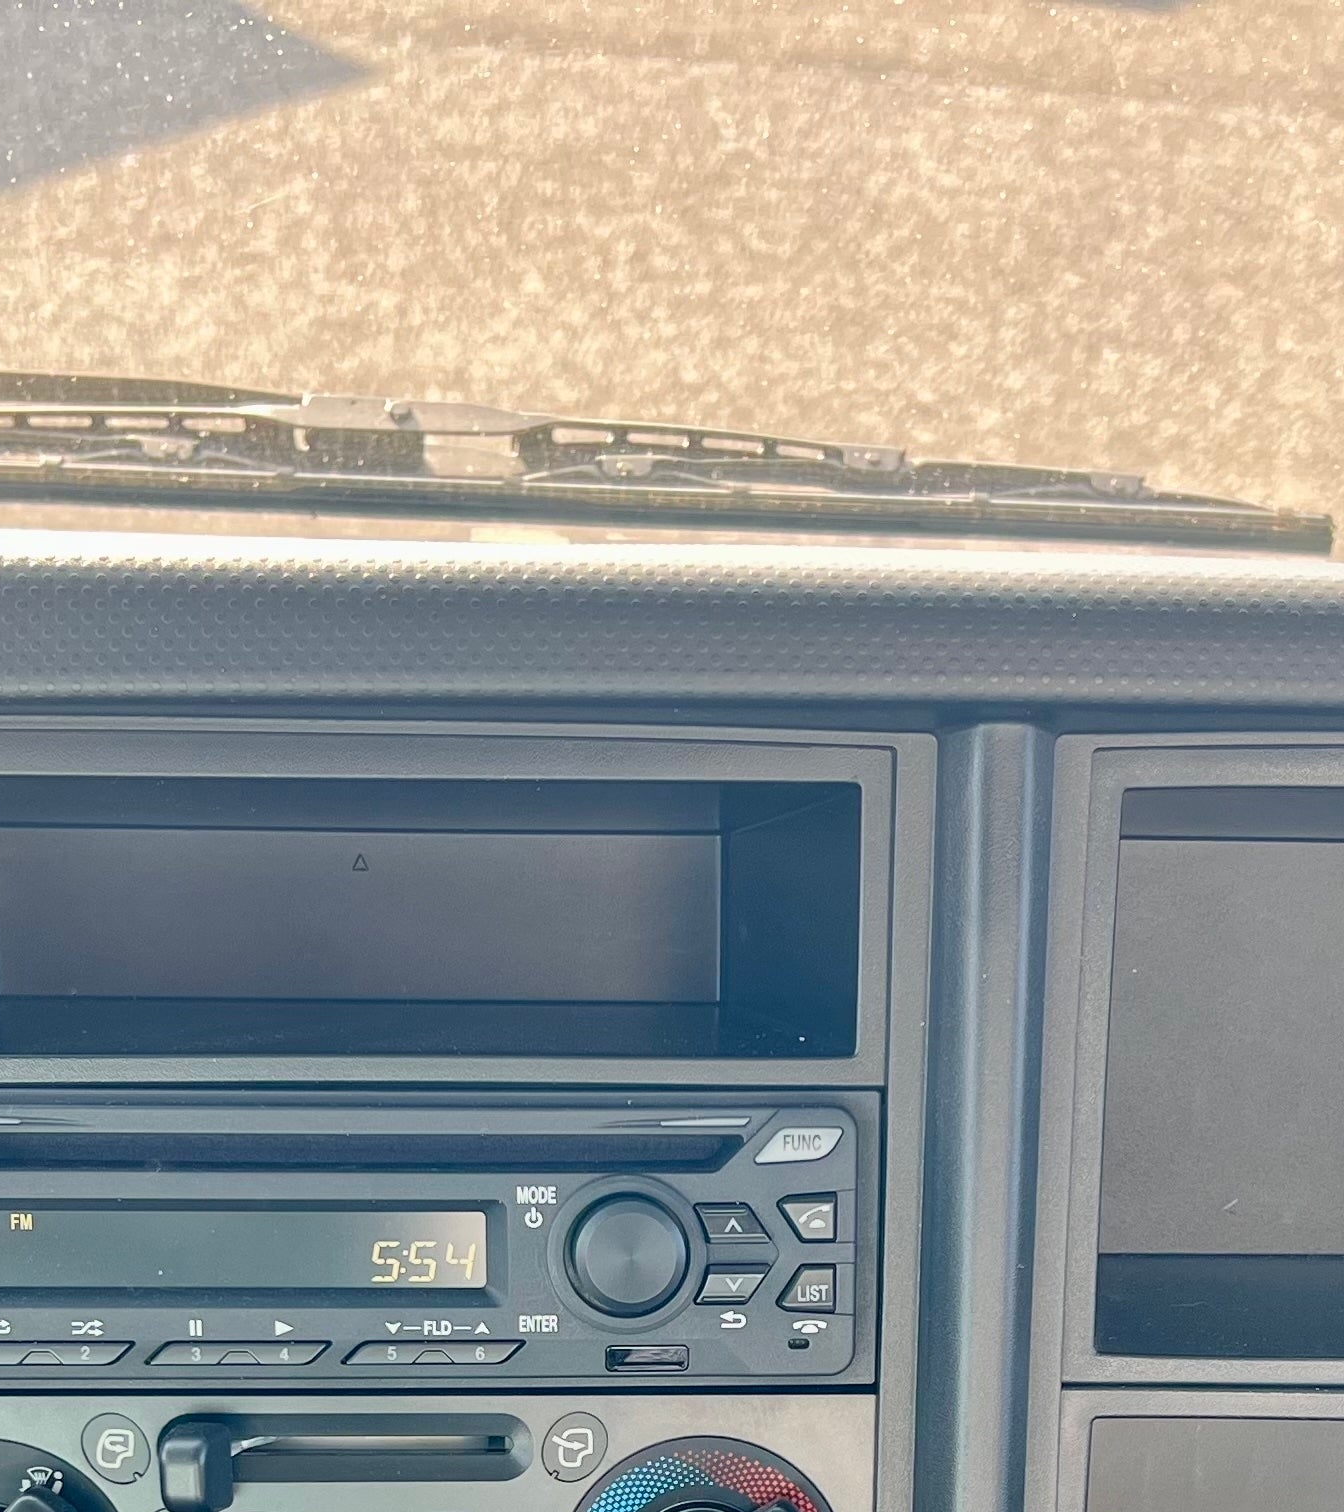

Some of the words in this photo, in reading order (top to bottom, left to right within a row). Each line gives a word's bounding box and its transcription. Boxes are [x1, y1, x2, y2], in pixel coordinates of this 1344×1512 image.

[783, 1134, 822, 1151] FUNC
[516, 1186, 557, 1205] MODE
[10, 1213, 33, 1231] FM
[371, 1241, 476, 1282] 5:54
[797, 1285, 828, 1302] LIST
[423, 1320, 453, 1337] FLD
[519, 1315, 559, 1334] ENTER
[80, 1346, 91, 1361] 2
[191, 1346, 201, 1362] 3
[278, 1346, 290, 1362] 4
[386, 1346, 398, 1361] 5
[475, 1346, 486, 1361] 6
